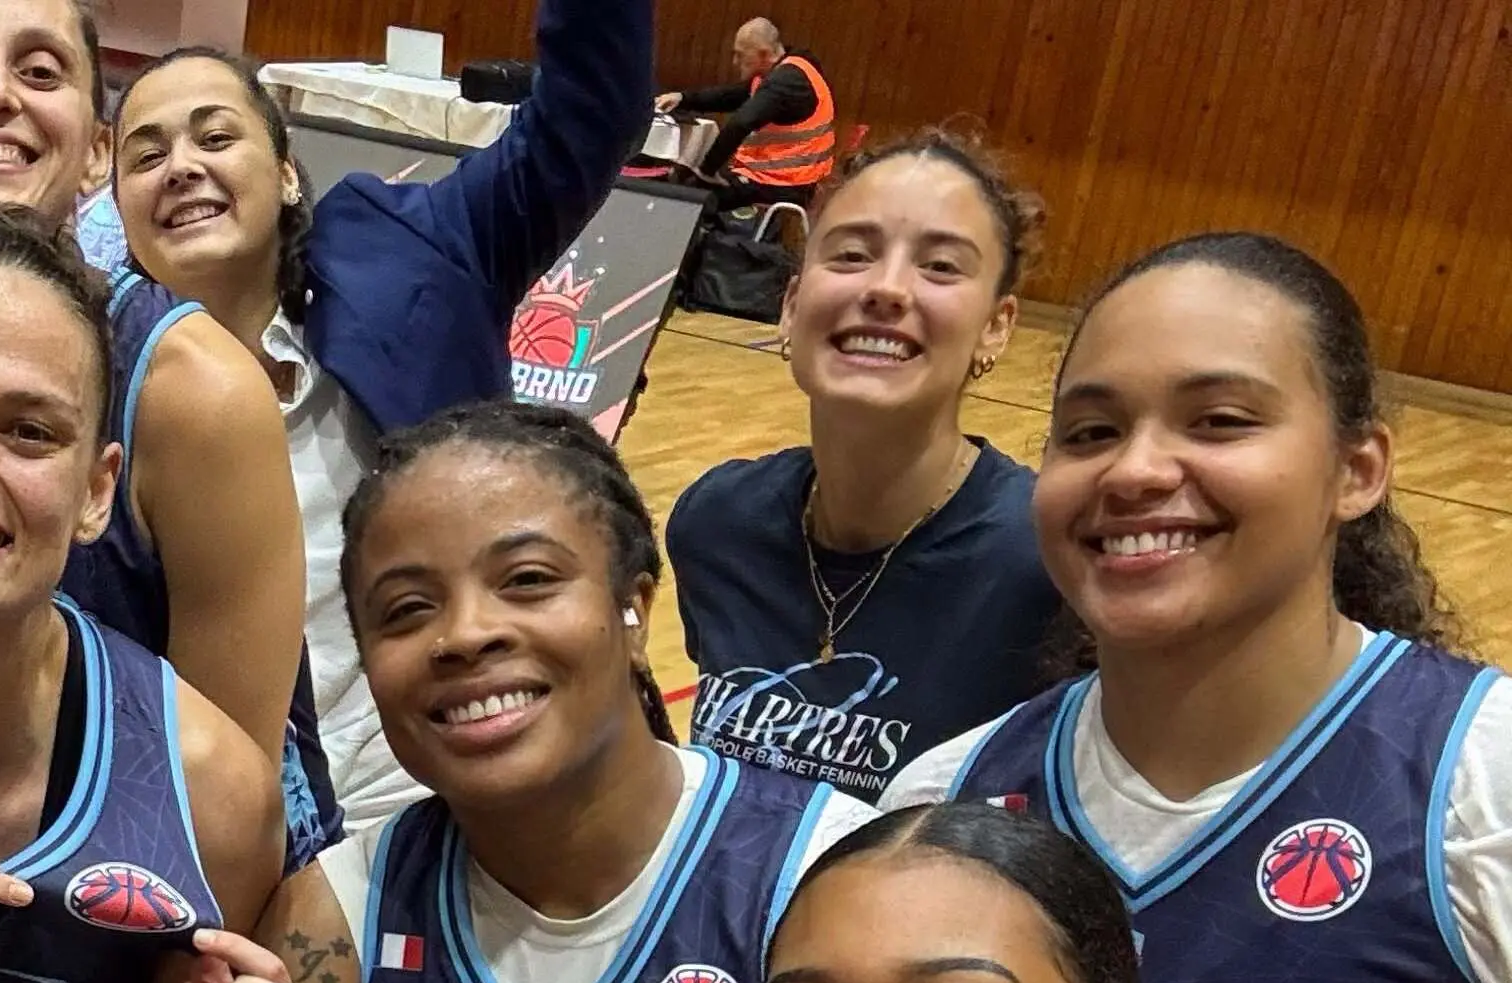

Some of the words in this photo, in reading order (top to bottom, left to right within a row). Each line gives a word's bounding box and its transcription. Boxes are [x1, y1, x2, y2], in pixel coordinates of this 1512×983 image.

[511, 361, 598, 403] BRNO
[755, 747, 818, 776] BASKET
[817, 764, 888, 791] FEMININ
